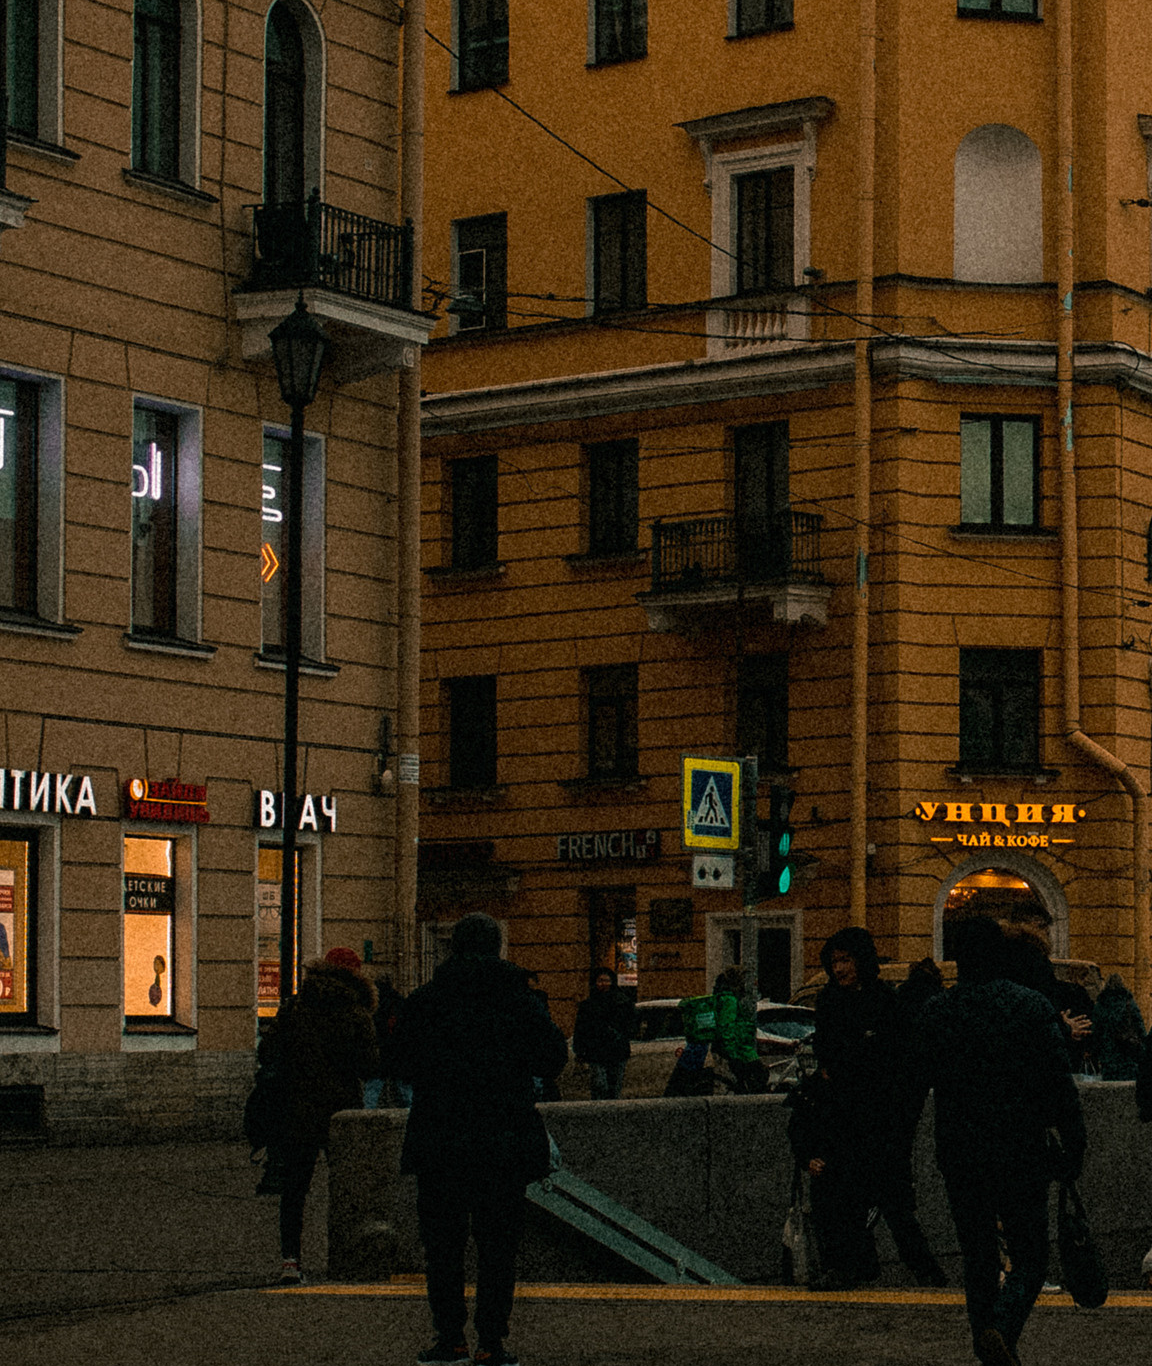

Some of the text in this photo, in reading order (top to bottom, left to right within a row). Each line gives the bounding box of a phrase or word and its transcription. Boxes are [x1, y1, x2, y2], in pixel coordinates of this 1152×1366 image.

[260, 790, 336, 832] ВАЧ
[919, 801, 1077, 828] УНЦИЯ
[557, 832, 635, 860] FRENCH
[125, 880, 166, 893] ЕТСКИЕ
[129, 896, 157, 908] ОЧКИ
